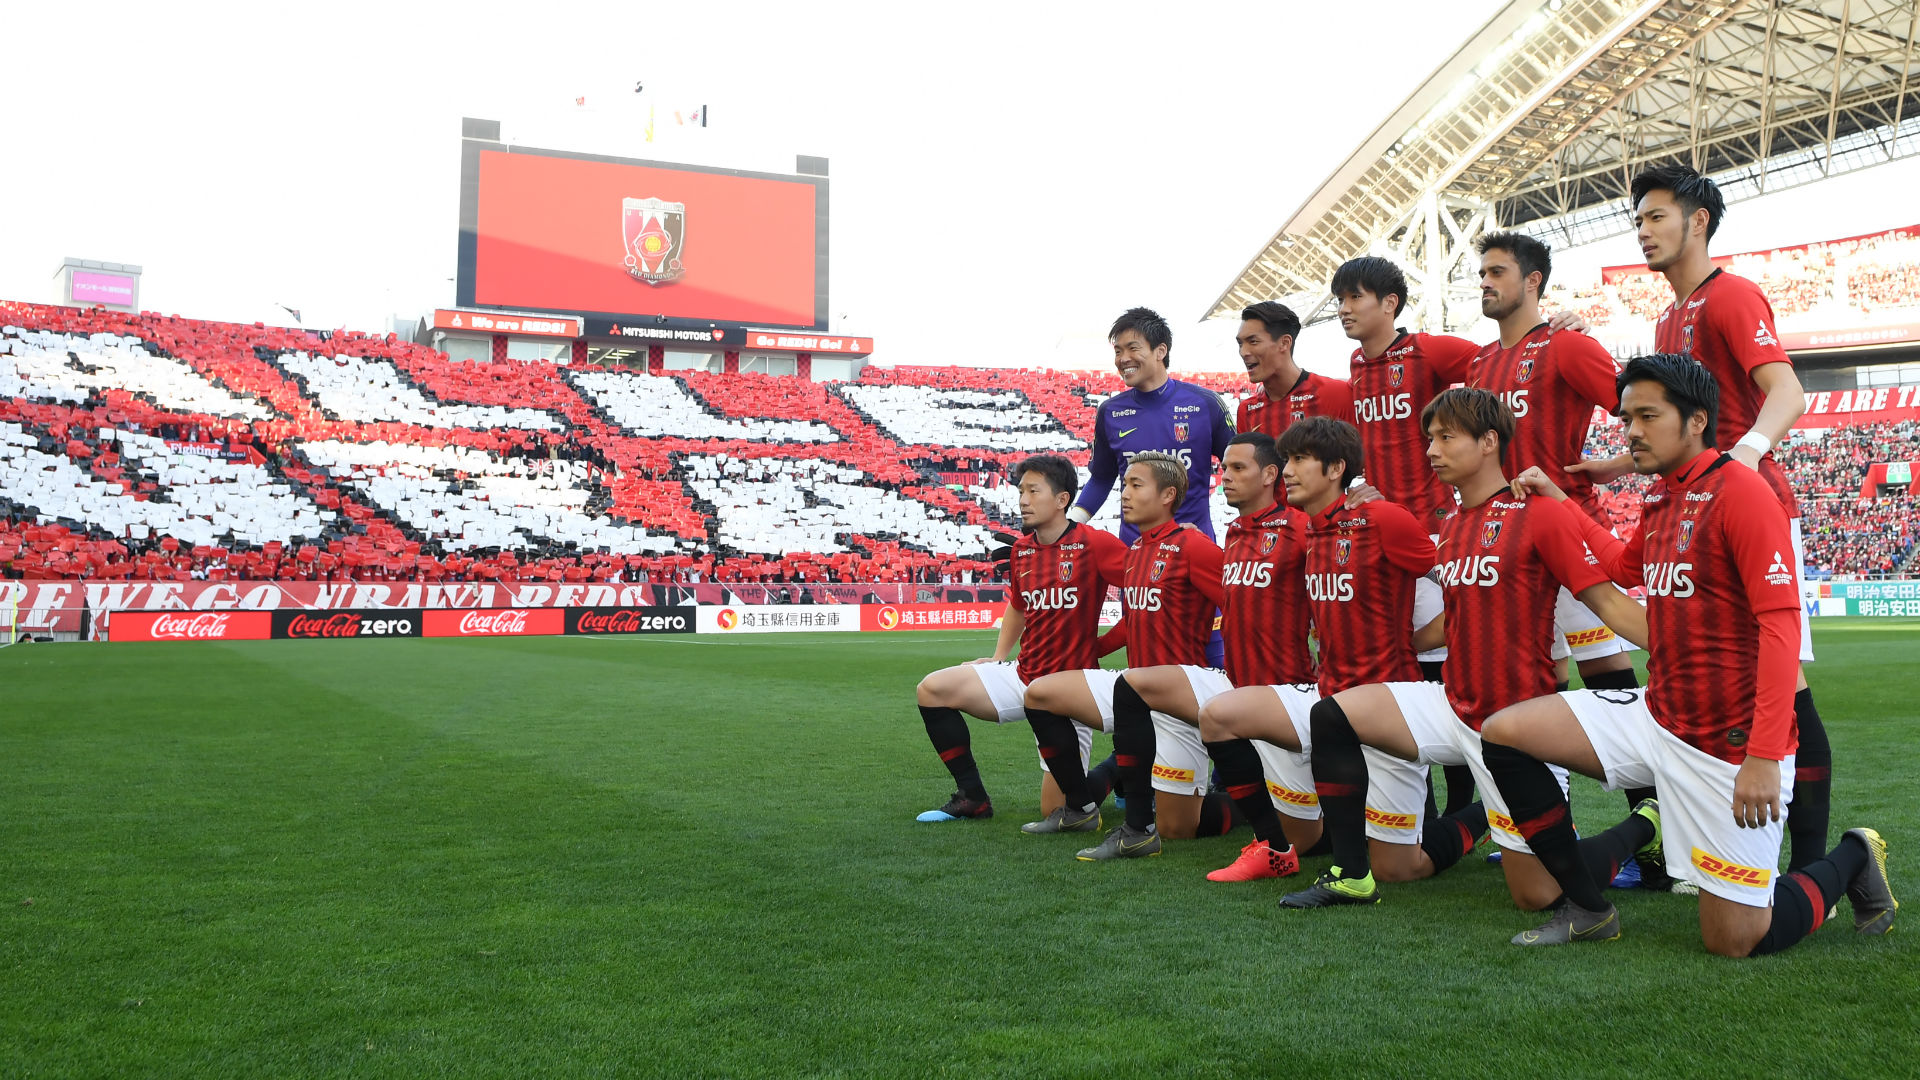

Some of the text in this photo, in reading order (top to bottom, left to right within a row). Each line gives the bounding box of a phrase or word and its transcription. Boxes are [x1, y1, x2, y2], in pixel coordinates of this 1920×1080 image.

[472, 316, 566, 334] We are REDS!
[622, 326, 673, 340] MITSUBISHI
[674, 330, 711, 342] MOTORS
[757, 335, 842, 350] Go REDS! Go!
[1174, 405, 1200, 413] EneCle
[1353, 392, 1412, 425] POLUS
[1834, 388, 1889, 413] ARE
[1111, 408, 1136, 418] EneCle
[170, 443, 220, 458] Fighting
[1491, 500, 1526, 509] EneCle
[1337, 518, 1367, 528] EneCle
[1060, 543, 1085, 551] EneCle
[740, 588, 762, 599] THE
[1021, 586, 1079, 612] POLUS
[151, 613, 231, 638] Coca-Cola
[288, 613, 411, 638] Coca-Cola zero
[459, 610, 530, 634] Coca-Cola
[577, 610, 686, 632] Coca-Cola zero
[742, 612, 840, 627] 埼玉縣信用金庫
[901, 610, 992, 625] 埼玉縣信用金庫
[1565, 628, 1609, 646] DHL
[1152, 766, 1187, 781] DHL
[1270, 785, 1313, 805] DHL
[1365, 809, 1409, 827] DHL
[1699, 855, 1761, 885] DHL
